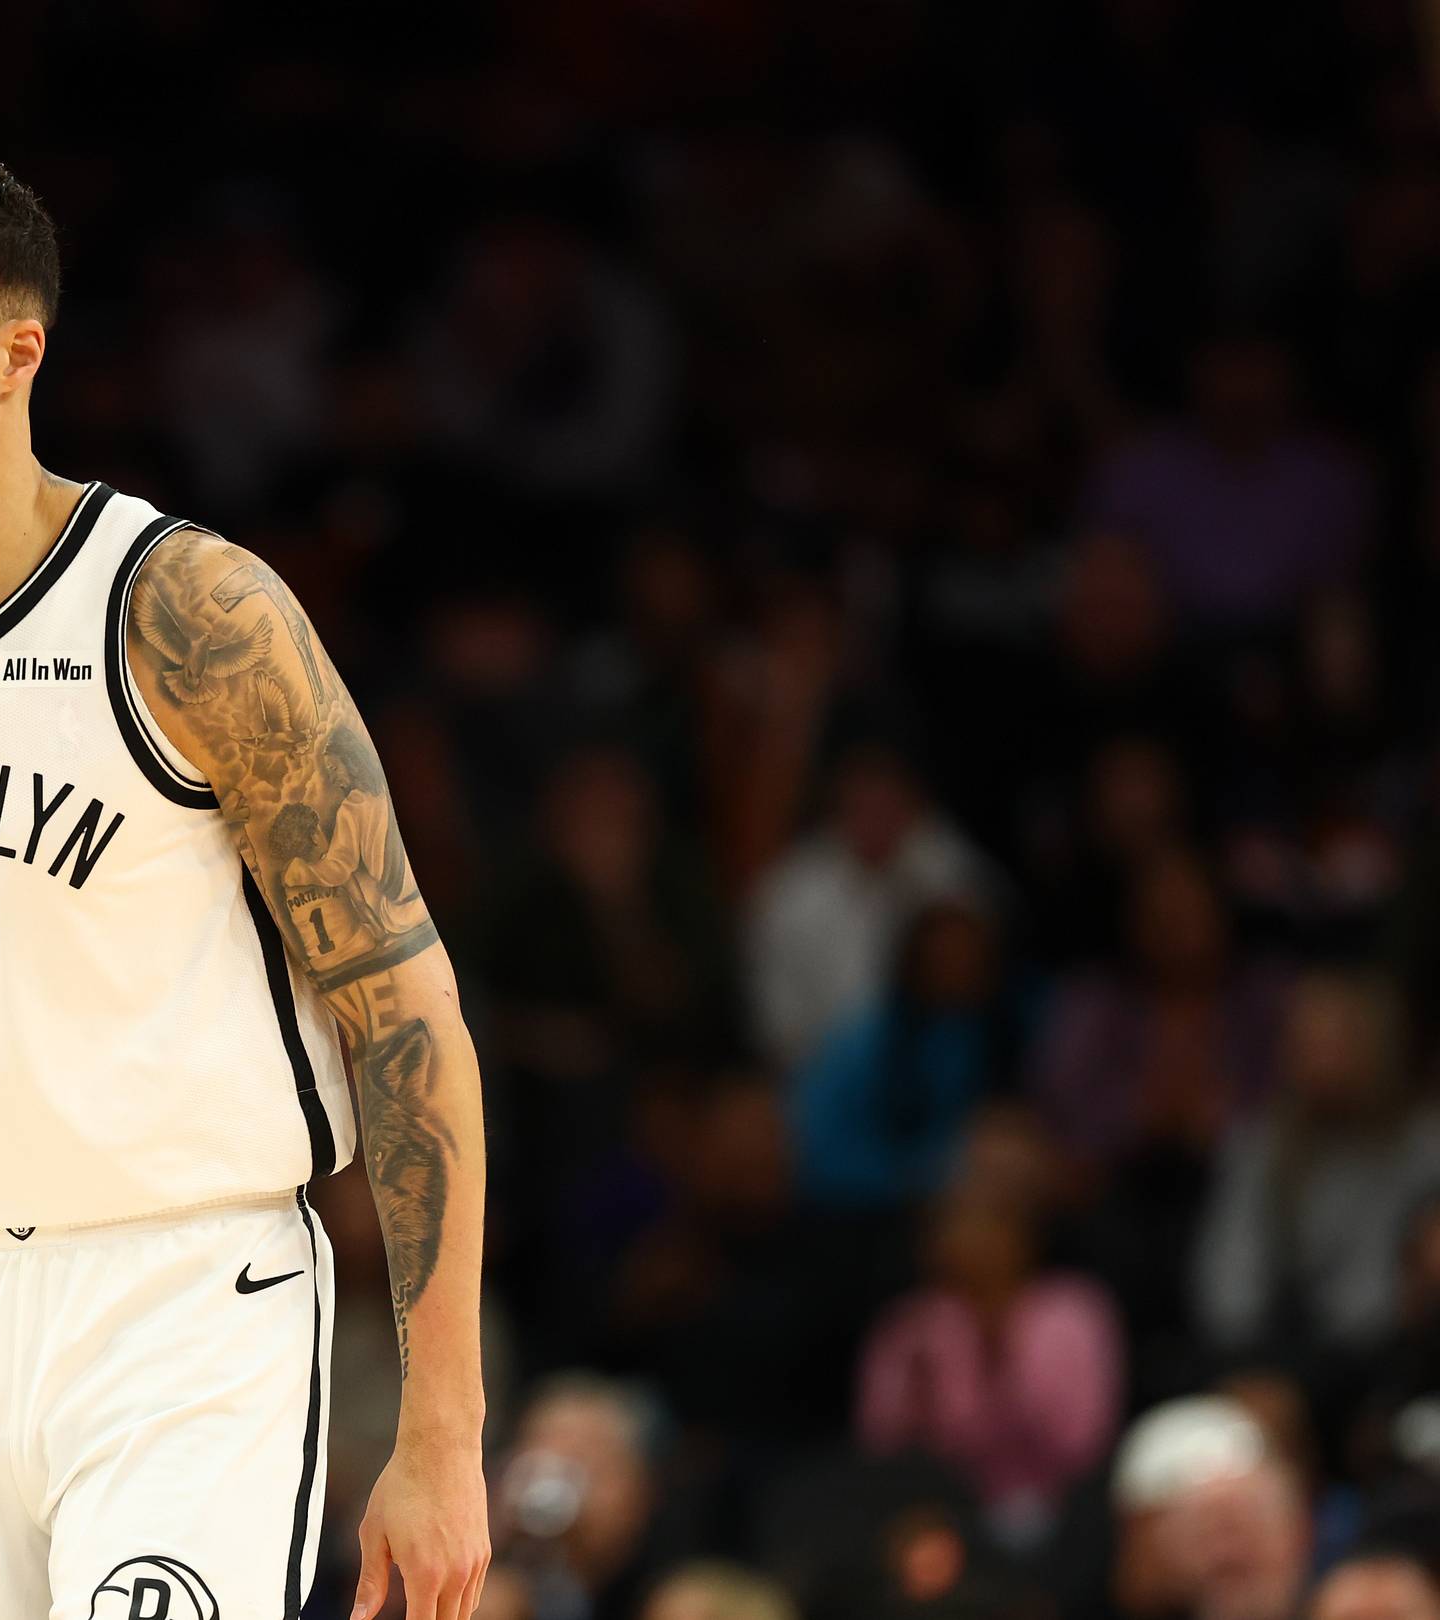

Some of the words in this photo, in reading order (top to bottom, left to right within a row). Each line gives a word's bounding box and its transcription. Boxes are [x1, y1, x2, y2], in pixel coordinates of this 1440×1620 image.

[2, 657, 27, 681] All
[32, 657, 48, 681] In
[53, 657, 92, 681] Won
[309, 907, 335, 954] 1
